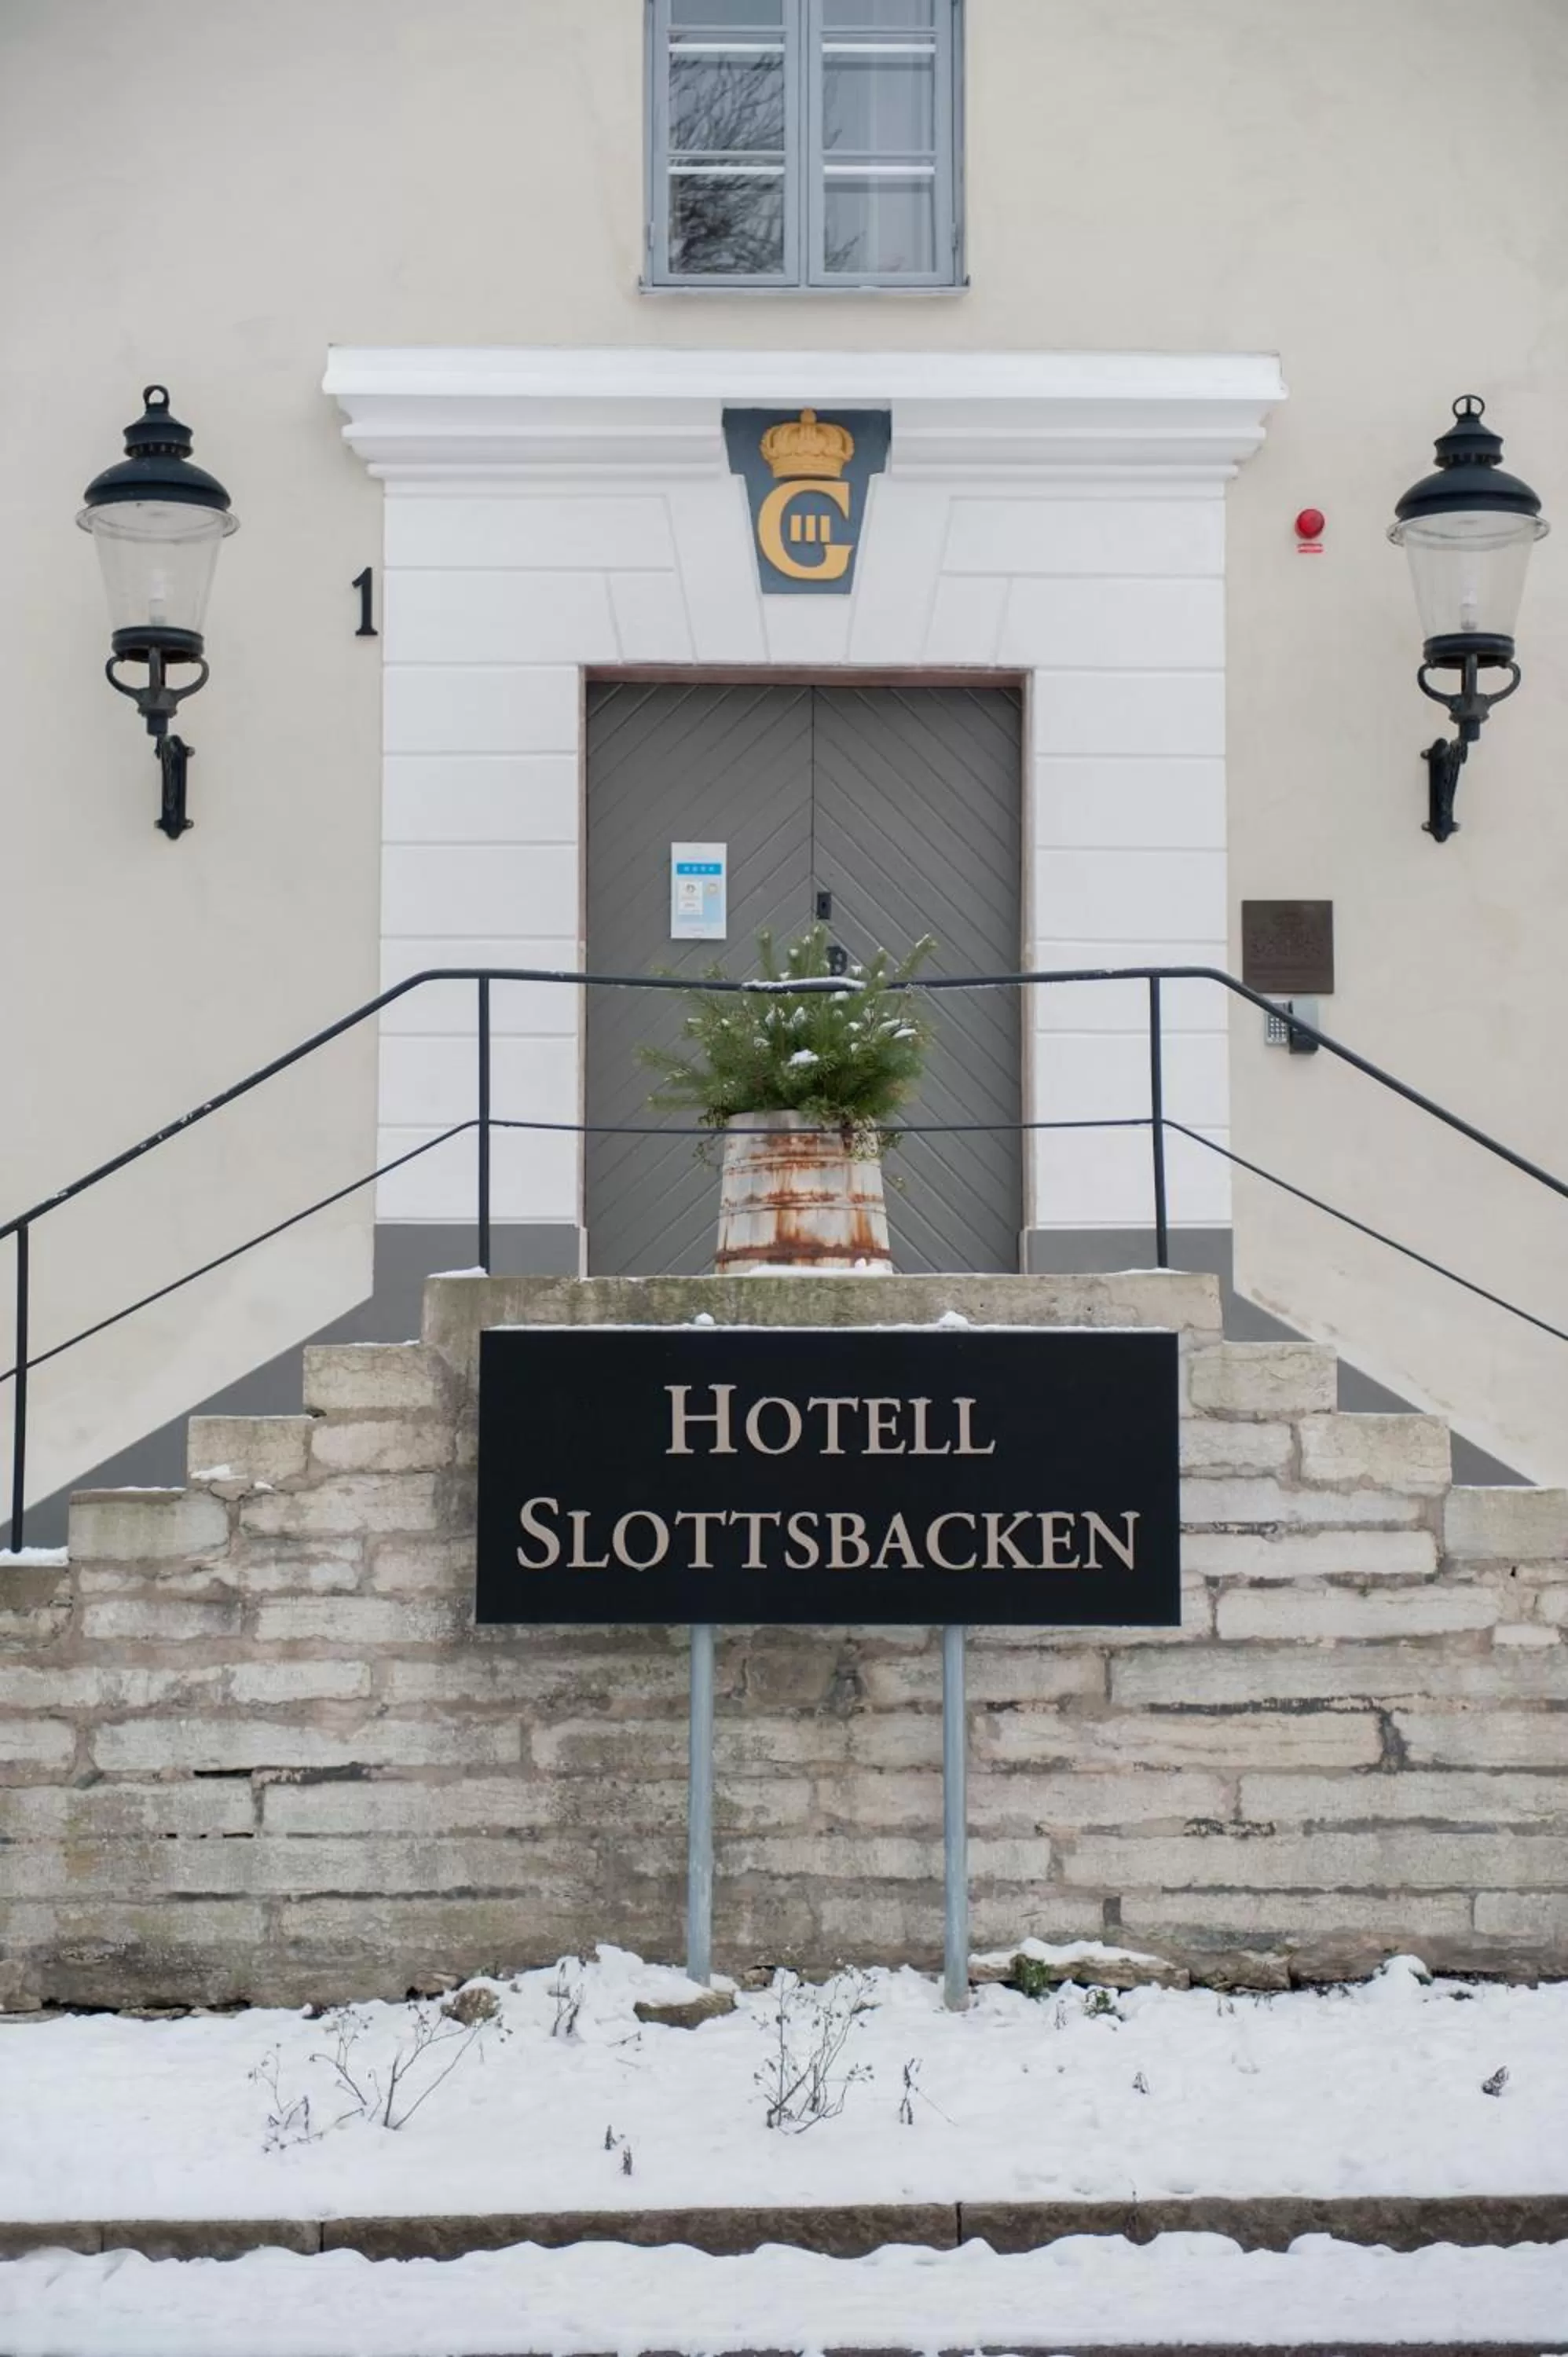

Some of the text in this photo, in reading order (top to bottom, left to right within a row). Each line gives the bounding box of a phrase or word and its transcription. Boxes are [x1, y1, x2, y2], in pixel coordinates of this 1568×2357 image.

[351, 566, 379, 636] 1
[664, 1384, 996, 1455] HOTELL
[517, 1497, 1141, 1571] SLOTTSBACKEN
